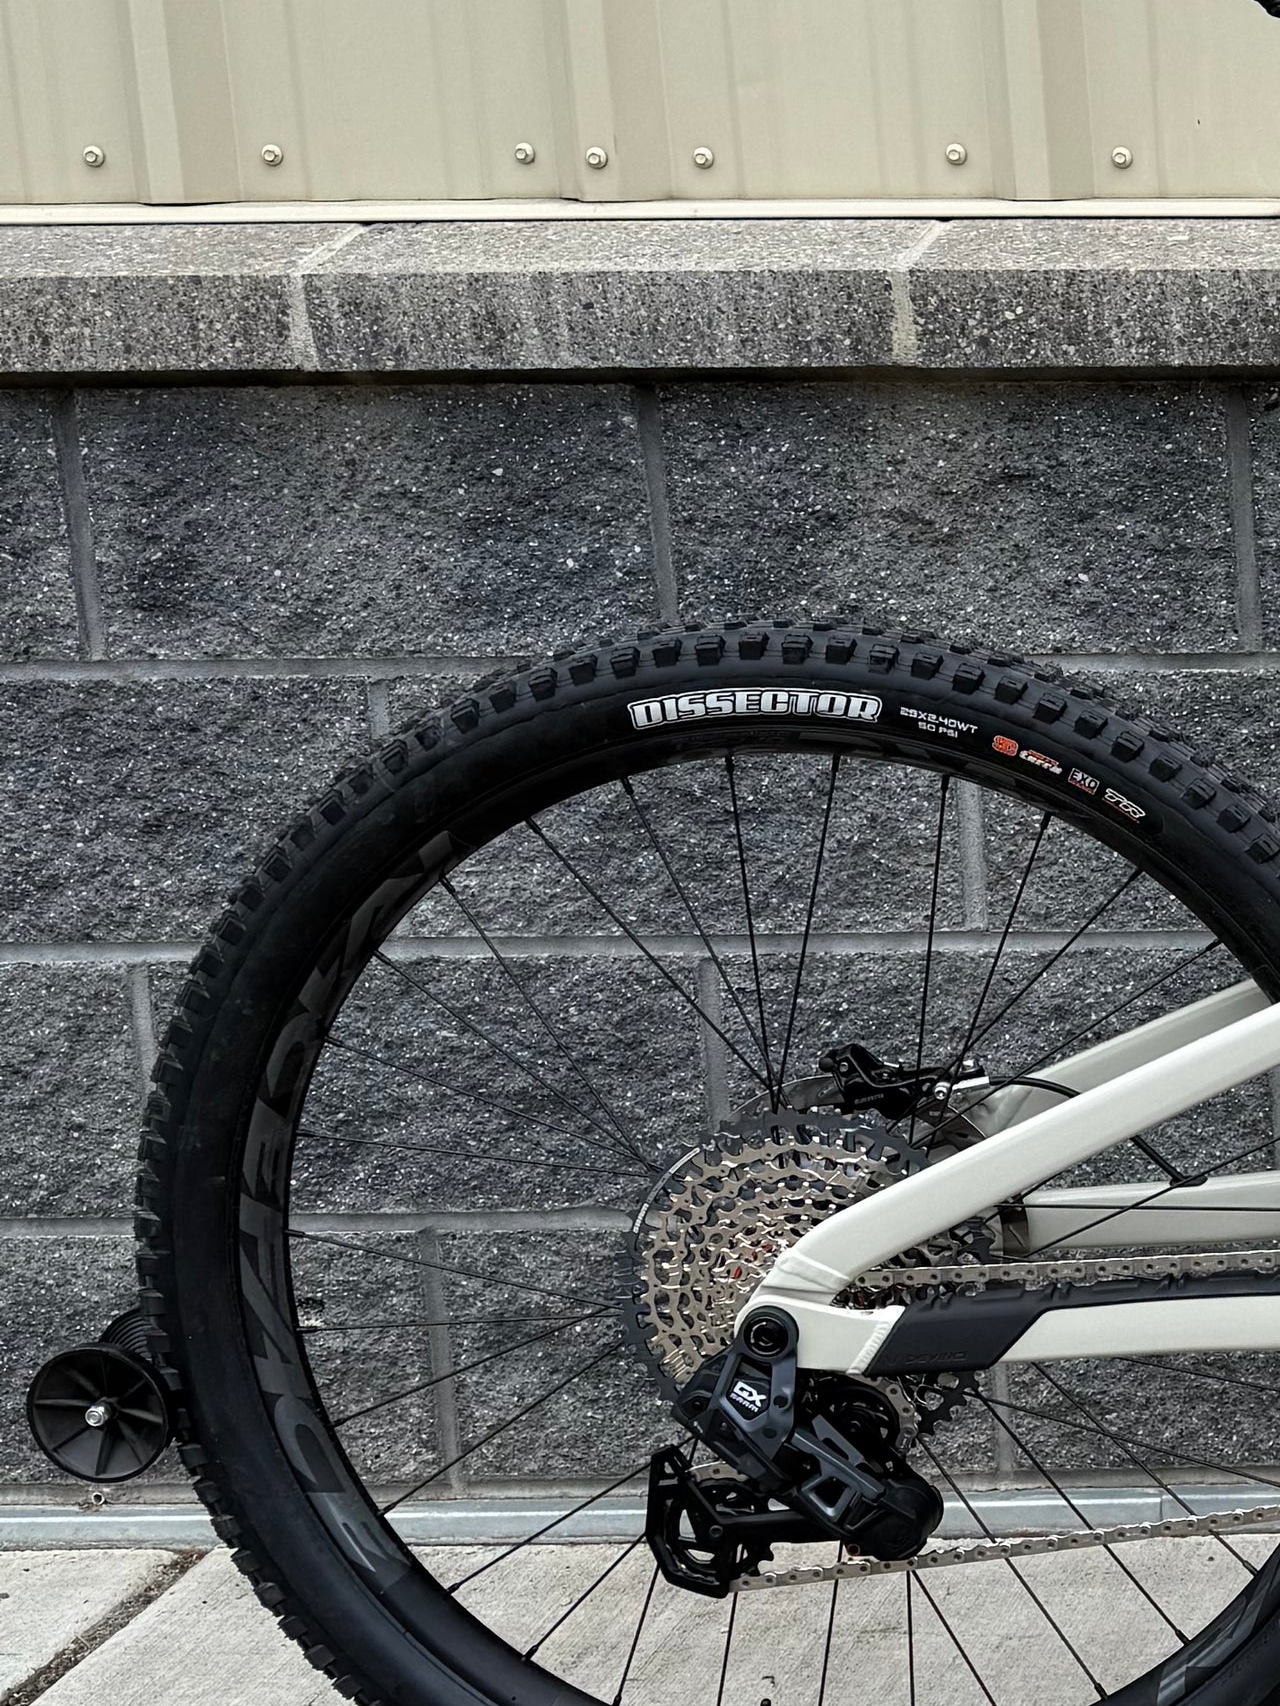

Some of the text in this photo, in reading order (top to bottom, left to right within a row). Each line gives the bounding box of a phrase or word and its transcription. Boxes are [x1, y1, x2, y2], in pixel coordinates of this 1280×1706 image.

[627, 687, 883, 731] DISSECTOR
[1070, 769, 1099, 791] EXO
[1104, 787, 1146, 820] TR
[729, 1392, 760, 1413] SRAM
[732, 1380, 768, 1408] GX
